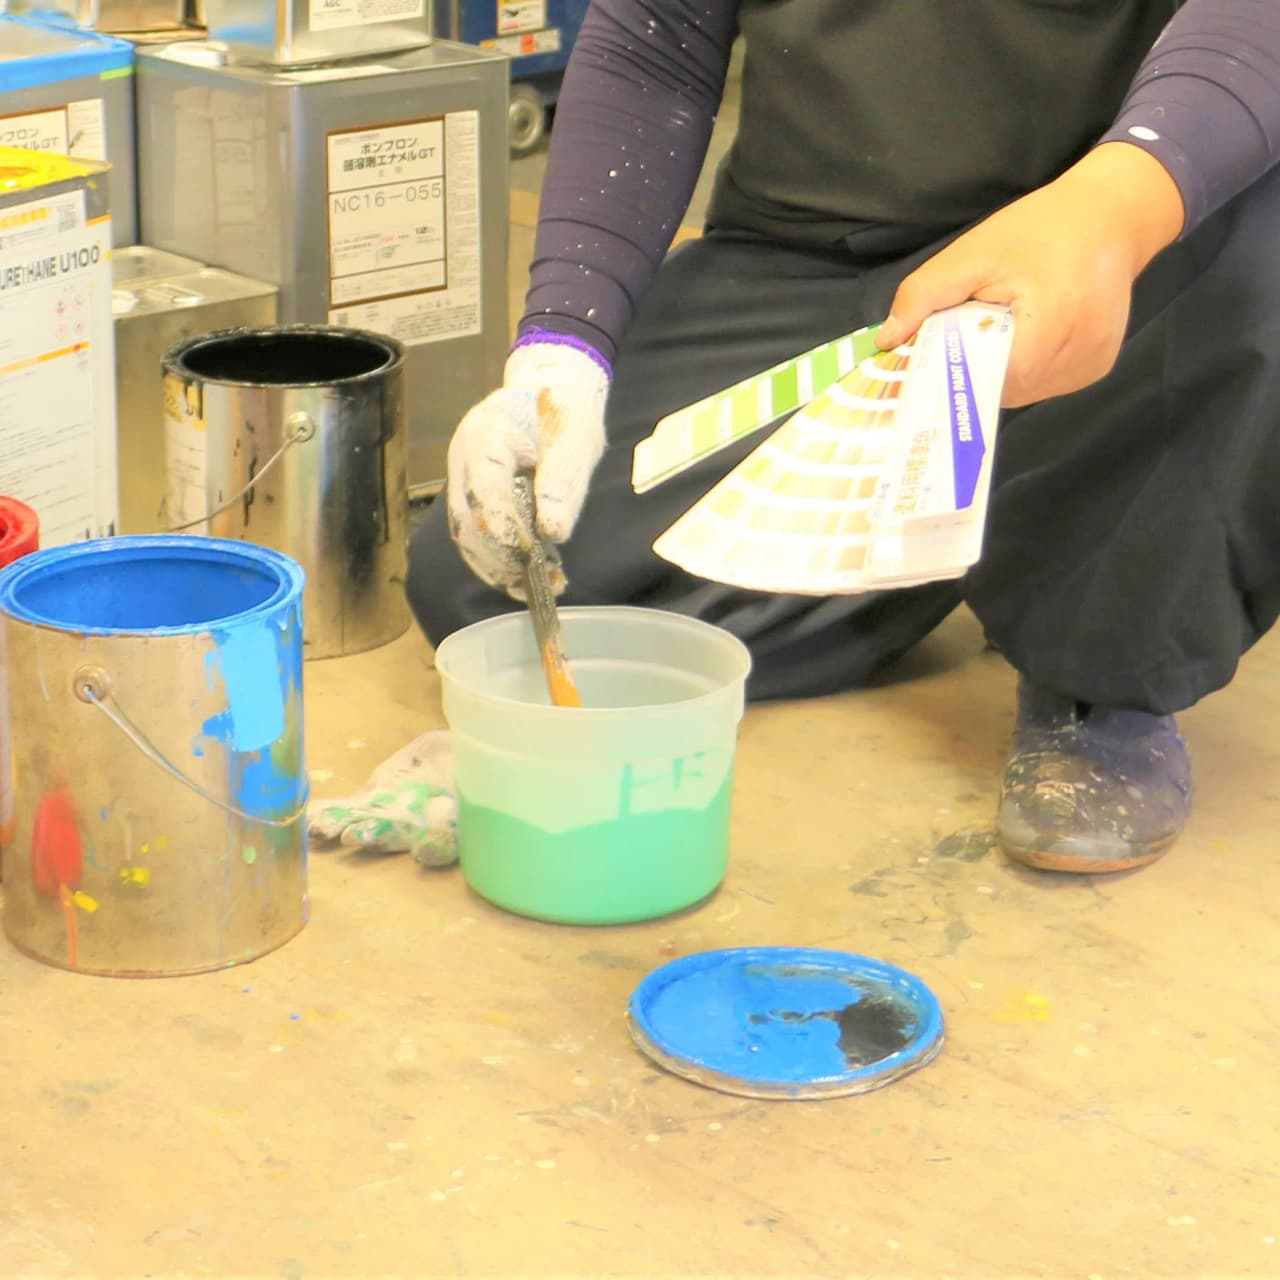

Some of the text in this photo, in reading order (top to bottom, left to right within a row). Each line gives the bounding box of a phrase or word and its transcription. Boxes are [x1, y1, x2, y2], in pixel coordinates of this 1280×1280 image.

[360, 136, 418, 155] ボンフロン
[333, 183, 442, 215] NC16-055
[59, 244, 101, 273] U100
[950, 364, 966, 391] PAINT
[954, 391, 973, 442] STANDARD
